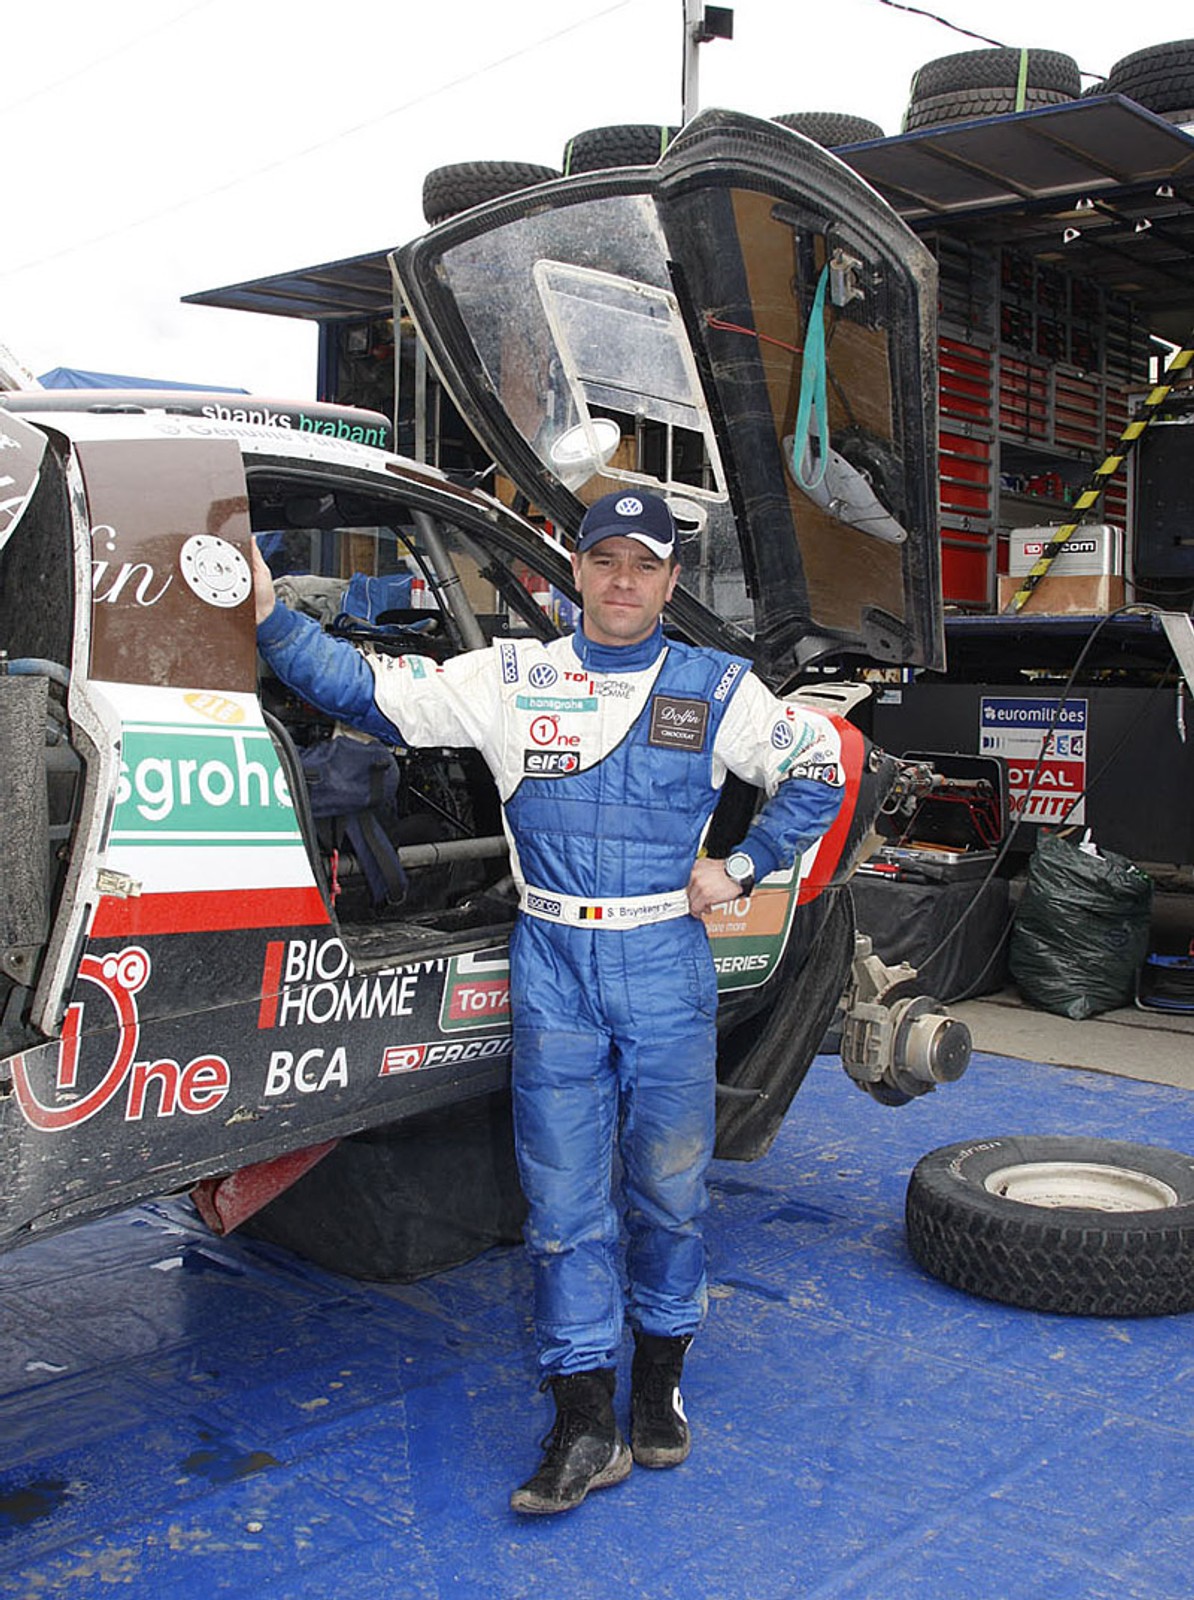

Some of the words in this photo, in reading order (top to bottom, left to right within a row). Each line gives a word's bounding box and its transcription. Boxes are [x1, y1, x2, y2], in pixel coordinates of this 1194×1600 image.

[299, 413, 388, 448] brabant
[660, 706, 699, 726] Dolfin
[527, 754, 559, 770] elf
[792, 765, 824, 780] elf
[279, 976, 418, 1027] HOMME
[264, 1047, 348, 1096] BCA
